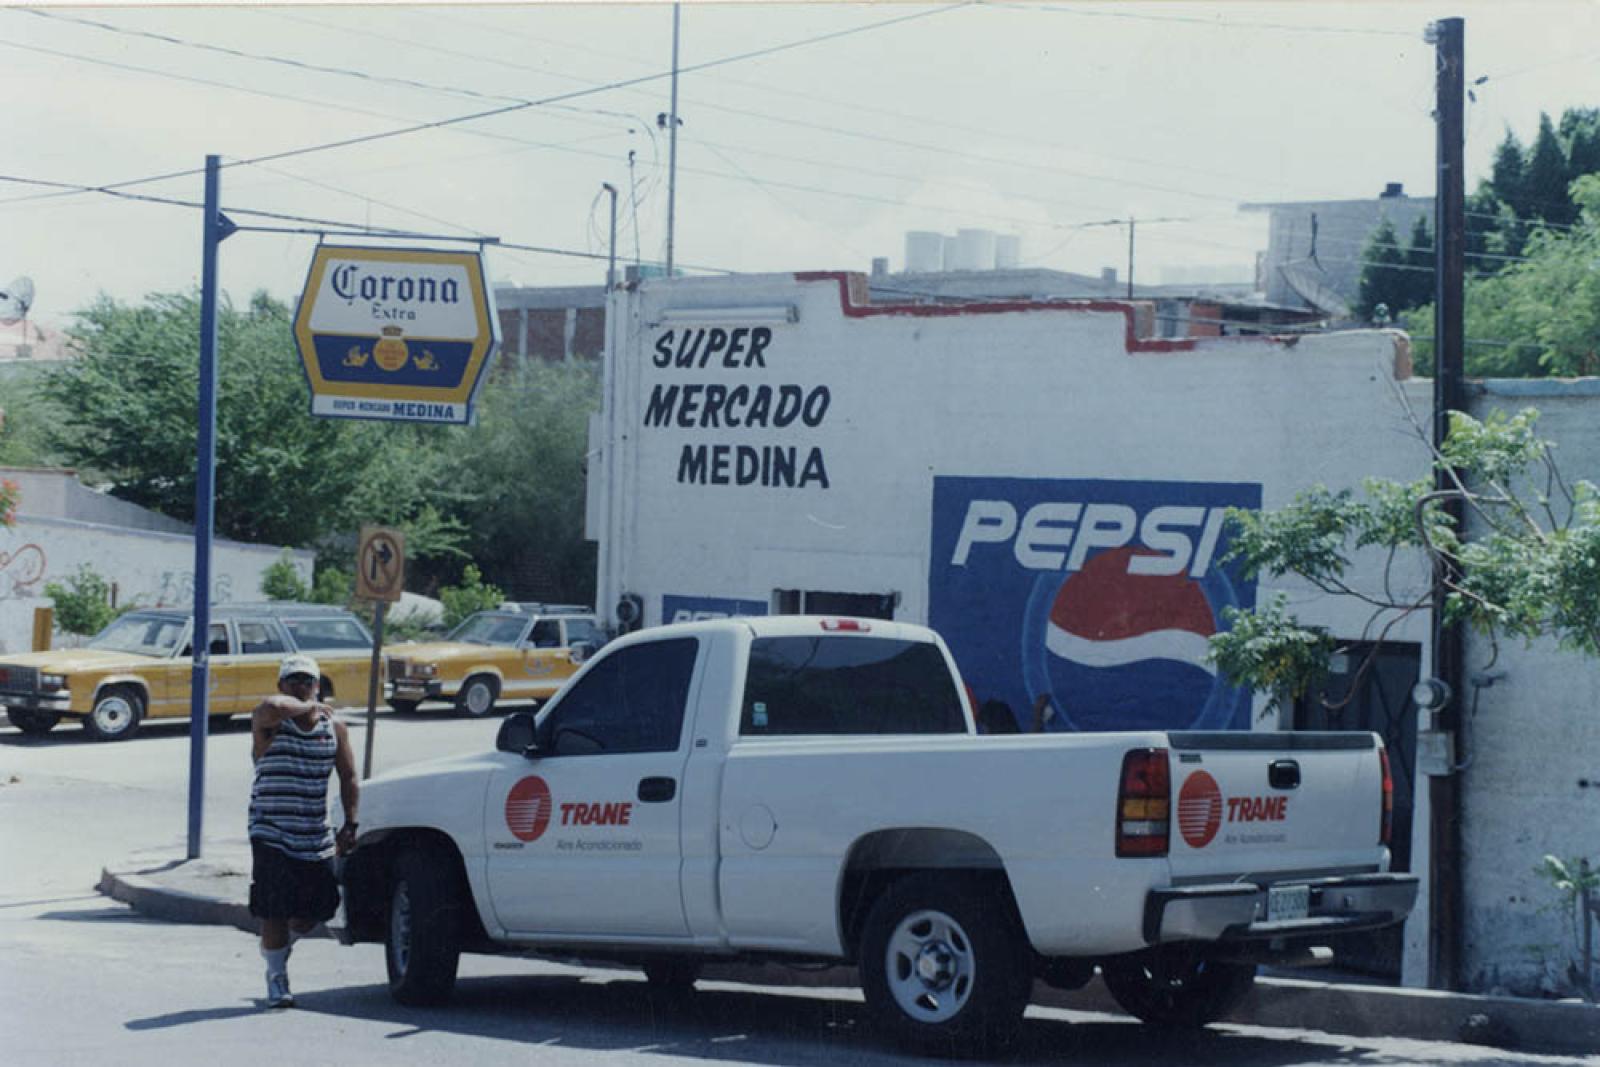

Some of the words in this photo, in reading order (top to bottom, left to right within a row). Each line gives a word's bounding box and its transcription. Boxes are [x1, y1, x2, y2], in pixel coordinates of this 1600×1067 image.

[331, 263, 459, 304] Corona
[371, 302, 417, 320] Extra
[652, 327, 772, 369] SUPER
[392, 401, 455, 419] MEDINA
[643, 383, 831, 428] MERCADO
[677, 444, 830, 489] MEDINA
[950, 499, 1226, 579] PEPSI
[559, 802, 633, 826] TRANE
[1226, 795, 1289, 823] TRANE
